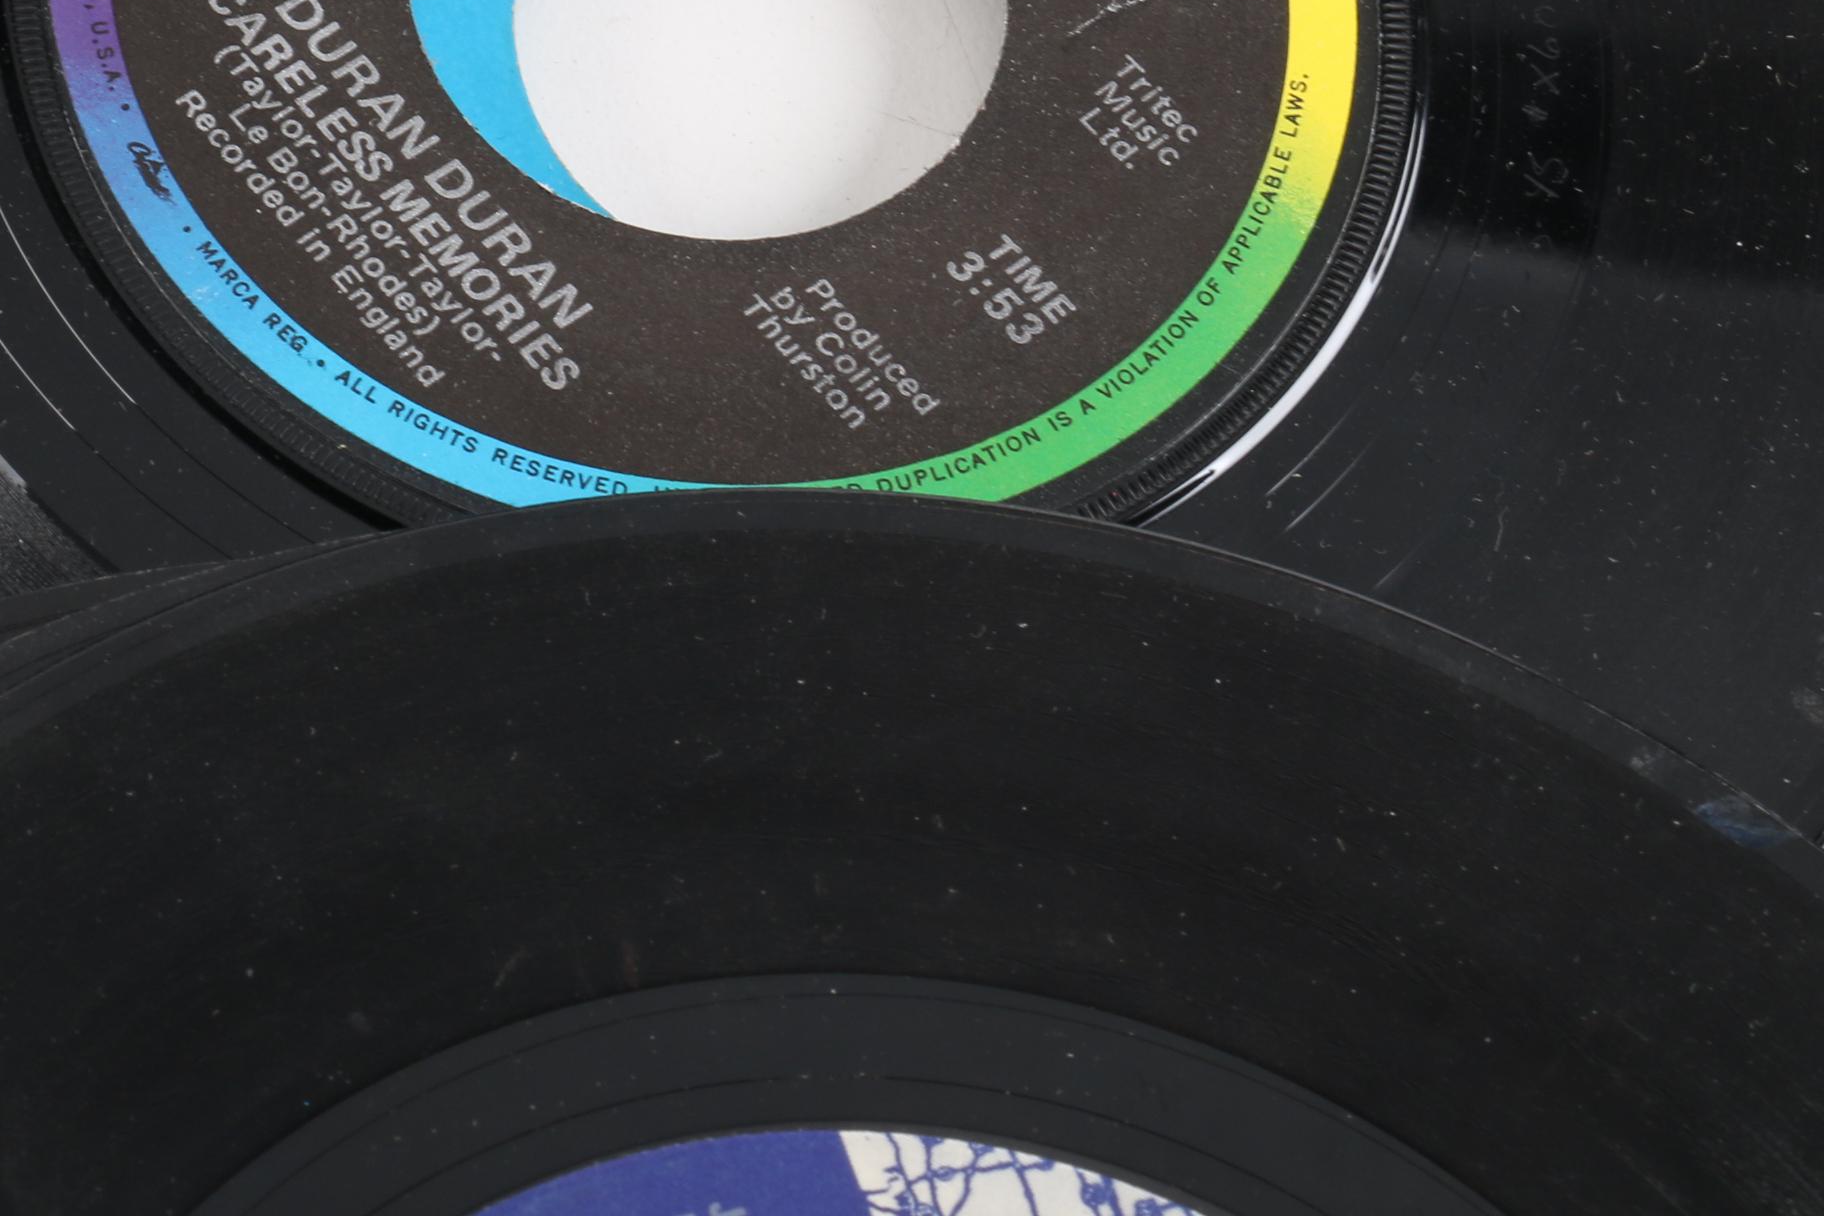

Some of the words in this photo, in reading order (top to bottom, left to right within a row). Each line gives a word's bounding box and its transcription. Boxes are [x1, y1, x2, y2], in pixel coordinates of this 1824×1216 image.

[90, 20, 123, 92] U.S.A.
[1117, 54, 1198, 144] Tritec
[228, 103, 269, 144] Le
[1078, 107, 1140, 170] Ltd.
[1094, 81, 1180, 167] Music
[175, 89, 306, 227] Recorded
[296, 228, 332, 263] in
[331, 264, 446, 388] England
[196, 240, 258, 310] MARCA
[334, 369, 378, 404] ALL
[388, 401, 478, 454] RIGHTS
[876, 427, 1042, 494] DUPLICATION
[1047, 411, 1073, 432] IS
[1078, 398, 1096, 415] A
[1095, 308, 1200, 400] VIOLATION
[1196, 276, 1222, 308] OF
[1221, 147, 1293, 276] APPLICABLE
[1280, 73, 1310, 138] LAWS.
[379, 179, 580, 390] MEMORIES
[424, 158, 594, 329] DURAN
[989, 233, 1077, 325] TIME
[770, 286, 816, 326] by
[814, 332, 891, 411] Colin
[805, 278, 941, 416] Produced
[946, 251, 1046, 344] 3:53
[743, 293, 866, 430] Thurston
